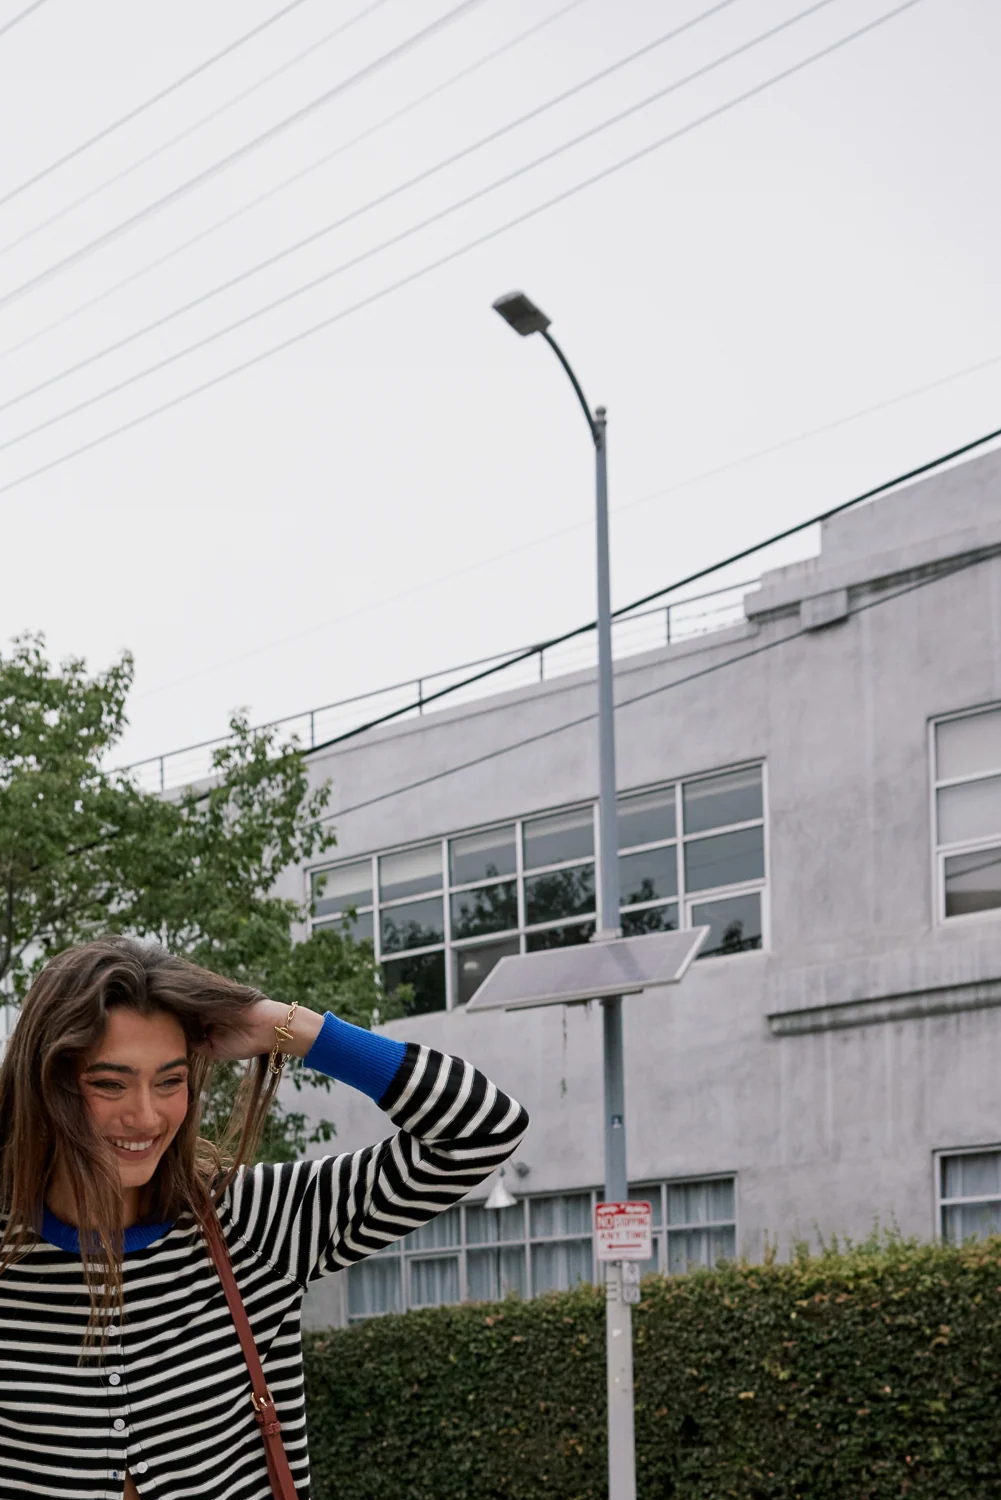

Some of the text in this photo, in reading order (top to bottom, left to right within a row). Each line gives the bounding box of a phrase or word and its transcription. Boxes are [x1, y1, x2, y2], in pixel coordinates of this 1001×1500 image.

[598, 1215, 648, 1229] NO STOPPING
[601, 1231, 647, 1240] ANY TIME
